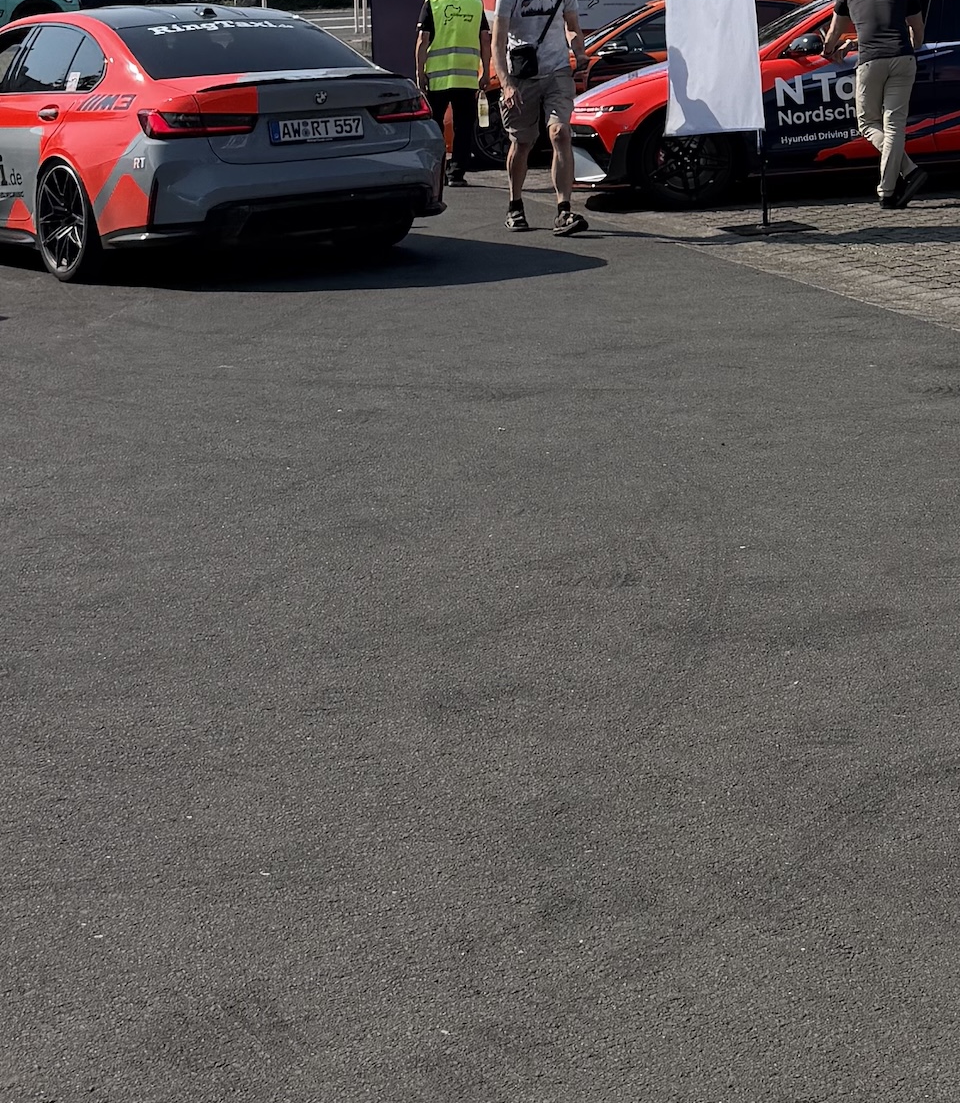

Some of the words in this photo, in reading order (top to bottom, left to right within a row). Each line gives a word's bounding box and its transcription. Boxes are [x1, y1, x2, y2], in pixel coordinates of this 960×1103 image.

[775, 75, 805, 107] N
[812, 72, 857, 102] Ta
[778, 103, 857, 126] Nordsch
[282, 123, 301, 138] AW
[312, 120, 330, 136] RT
[335, 117, 361, 134] 557
[781, 133, 817, 145] Hyundai
[818, 130, 849, 141] Driving
[133, 157, 146, 169] RT
